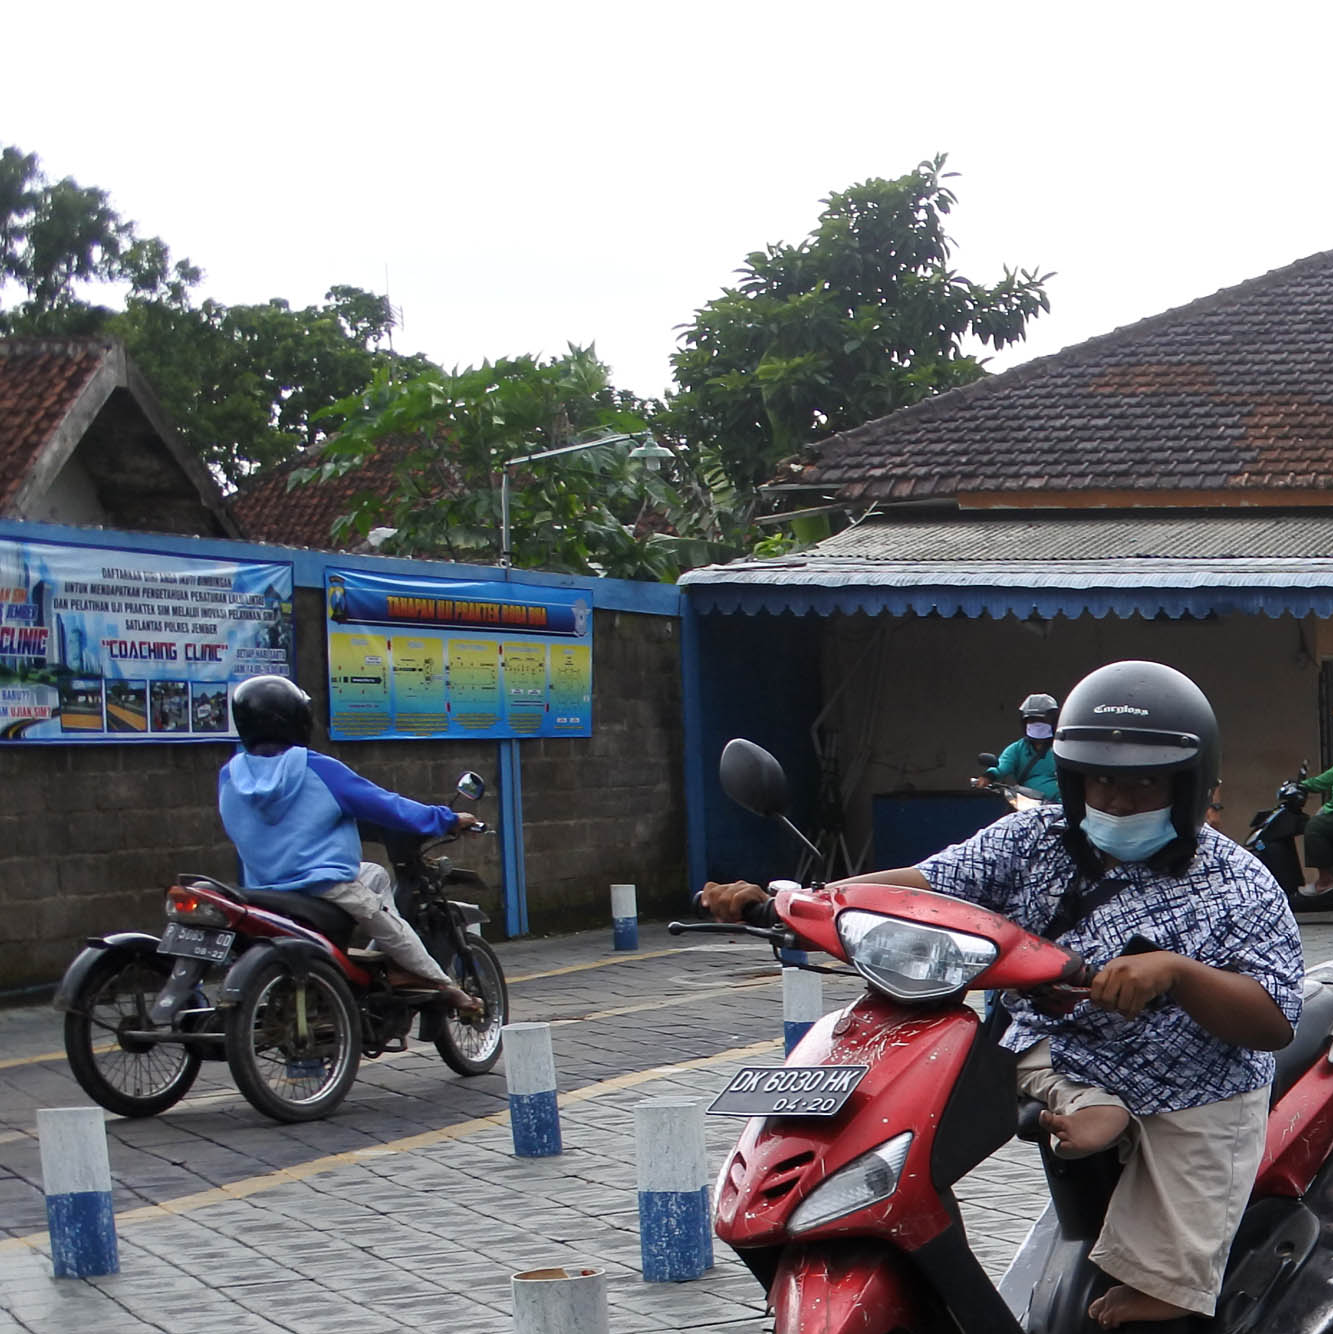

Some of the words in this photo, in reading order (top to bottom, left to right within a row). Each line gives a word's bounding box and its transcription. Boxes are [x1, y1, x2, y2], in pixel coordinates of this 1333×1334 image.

[64, 581, 89, 594] UNTUK
[90, 582, 141, 598] MENDAPATKAN
[53, 598, 69, 610] DAN
[70, 599, 109, 613] PELATIHAN
[110, 602, 123, 613] UJI
[124, 602, 156, 615] PRAKTEK
[125, 619, 163, 632] SATLANTAS
[164, 621, 190, 634] POLRES
[191, 623, 218, 635] JEMBER
[1094, 704, 1149, 716] Cargloss
[729, 1071, 768, 1092] DK
[764, 1071, 825, 1093] 6030
[820, 1071, 860, 1092] HK
